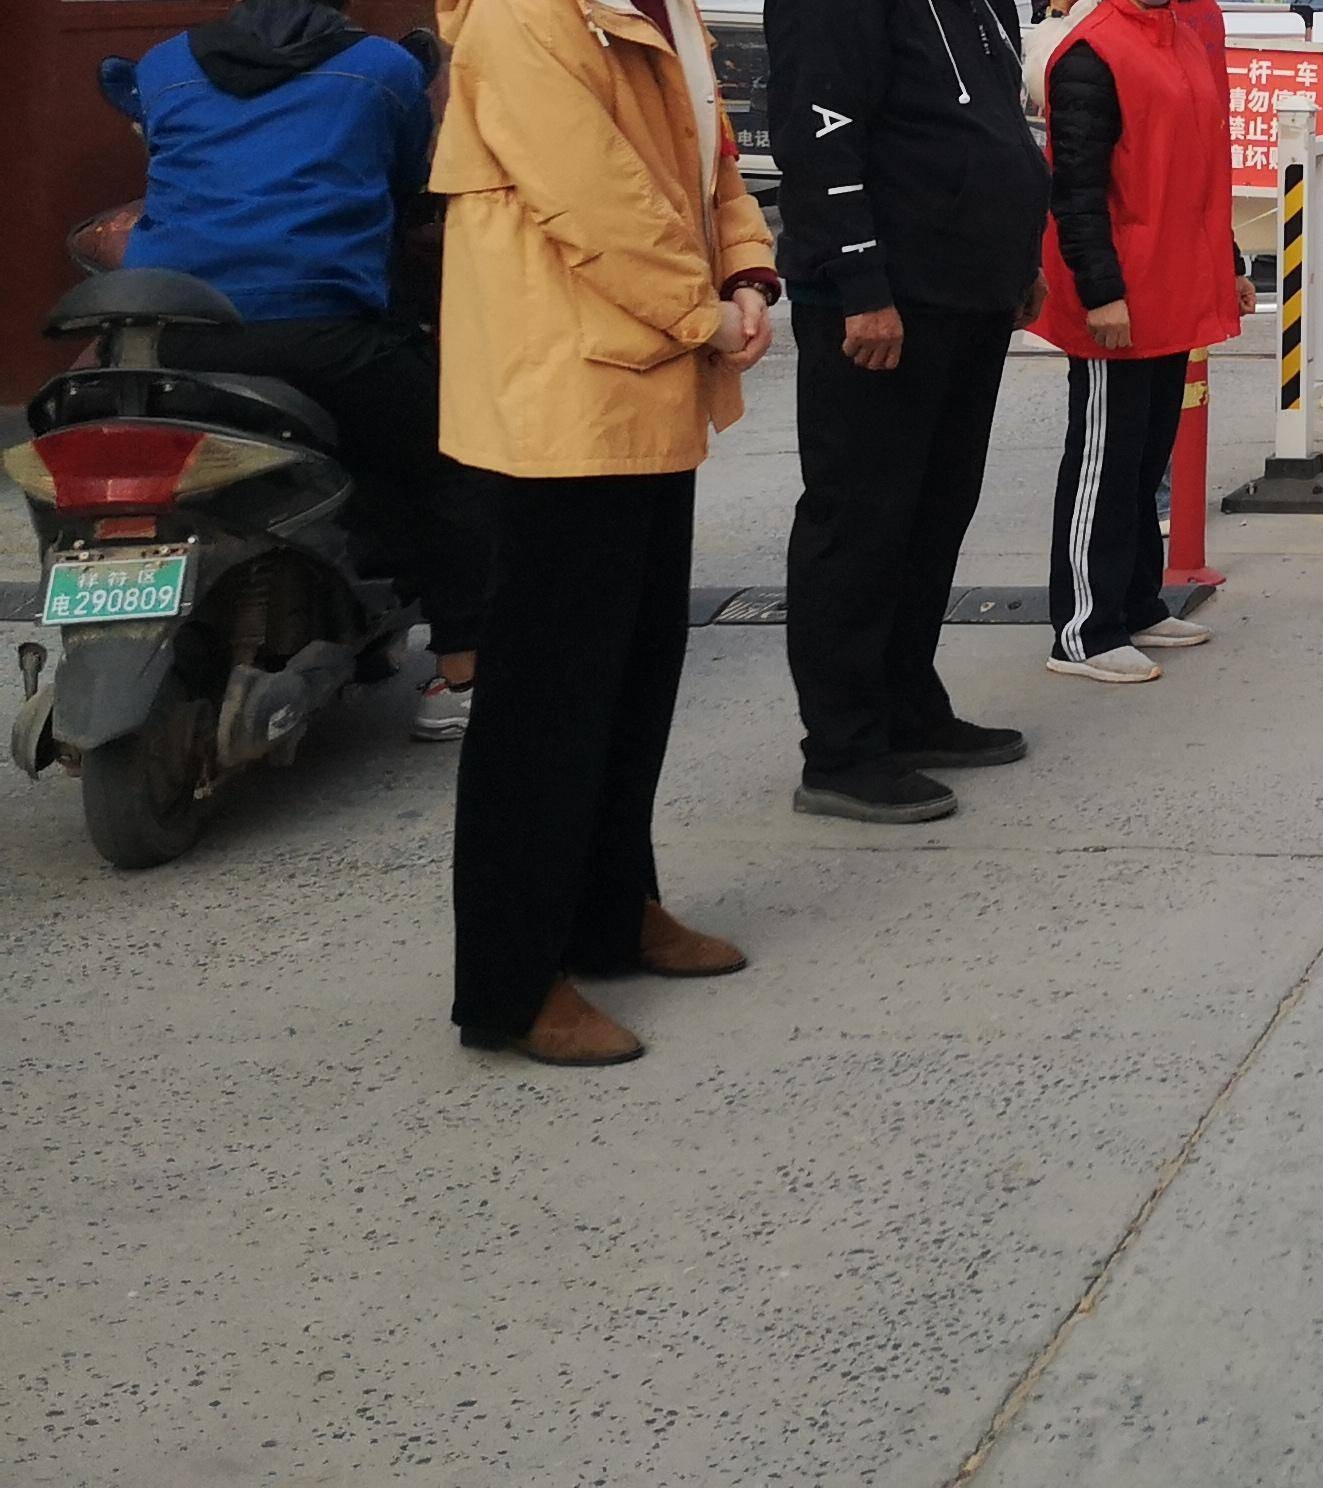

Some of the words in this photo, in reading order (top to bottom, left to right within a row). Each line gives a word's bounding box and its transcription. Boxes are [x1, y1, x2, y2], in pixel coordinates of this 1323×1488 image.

[1227, 59, 1318, 87] 一杆一车
[738, 130, 770, 147] 电话
[52, 585, 173, 616] 电290809
